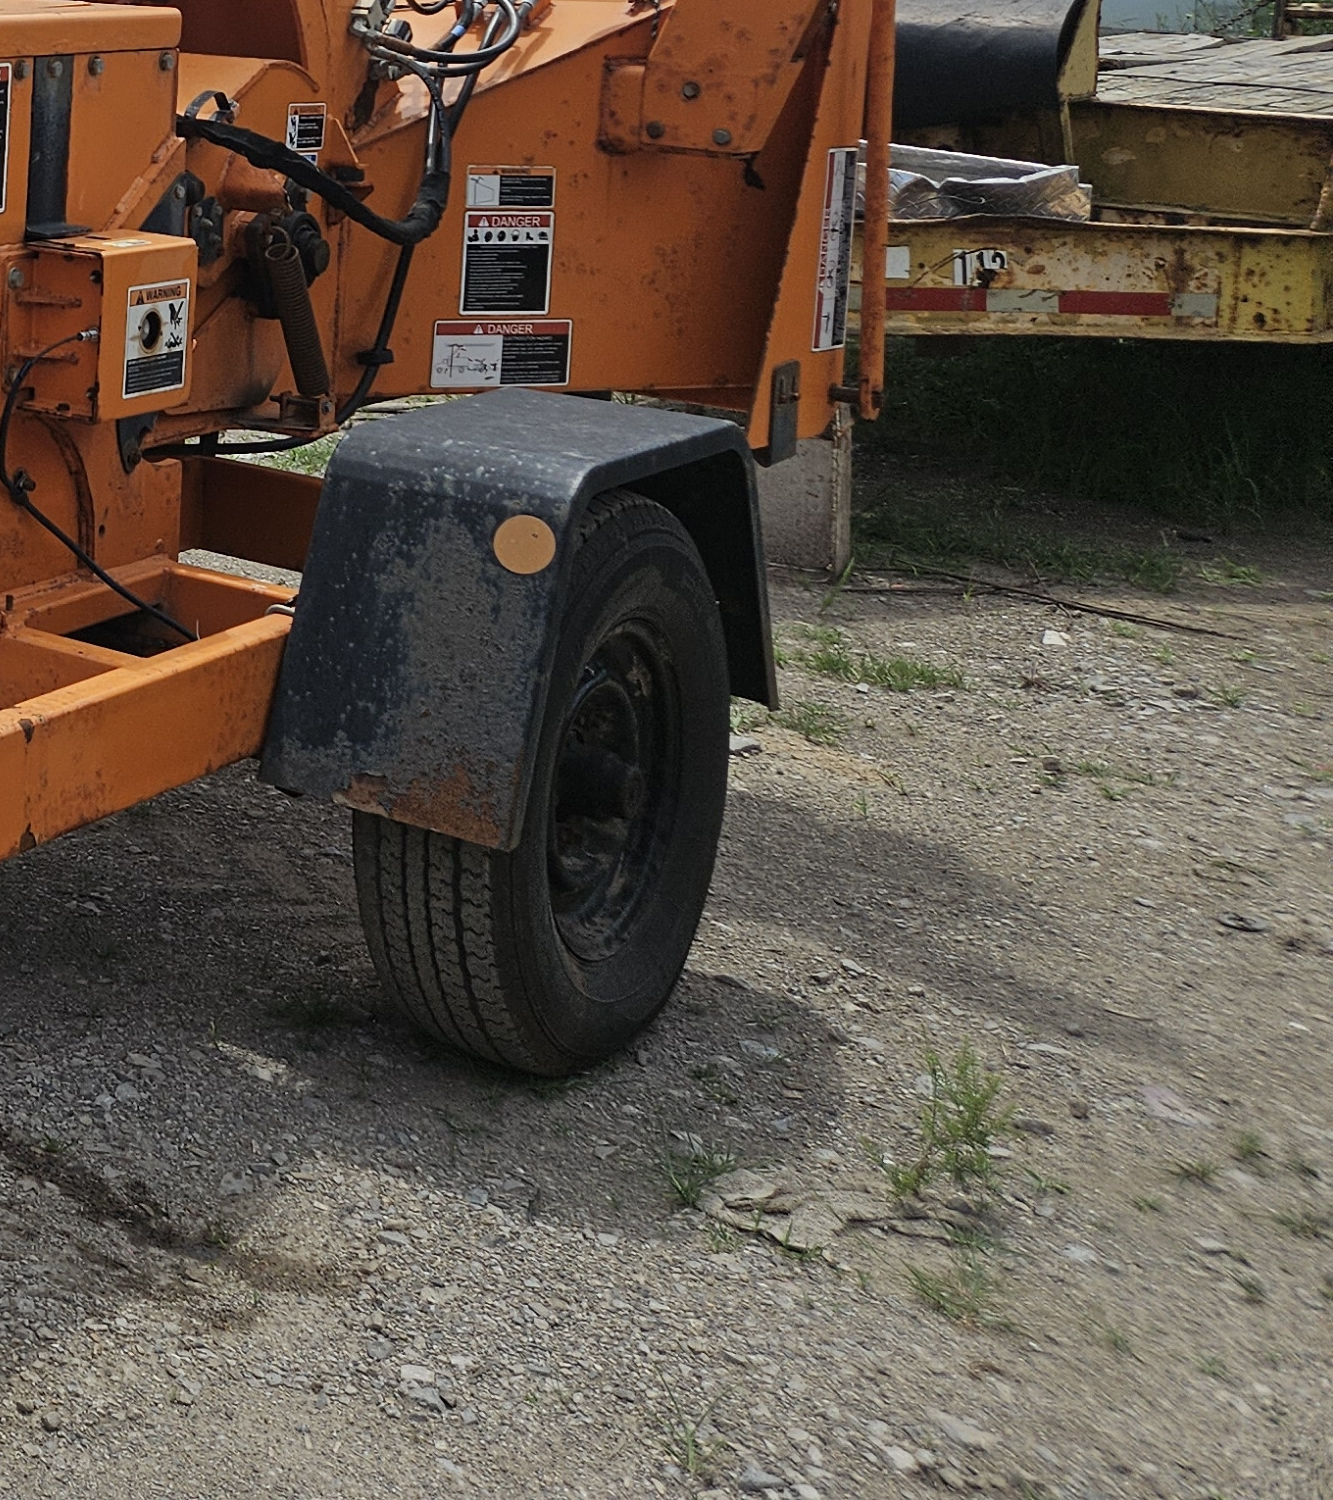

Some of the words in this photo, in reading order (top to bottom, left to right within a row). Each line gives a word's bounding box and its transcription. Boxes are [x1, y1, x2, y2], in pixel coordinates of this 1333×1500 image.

[491, 216, 541, 227] DANGER
[146, 286, 182, 301] WARNING
[487, 324, 534, 335] DANGER
